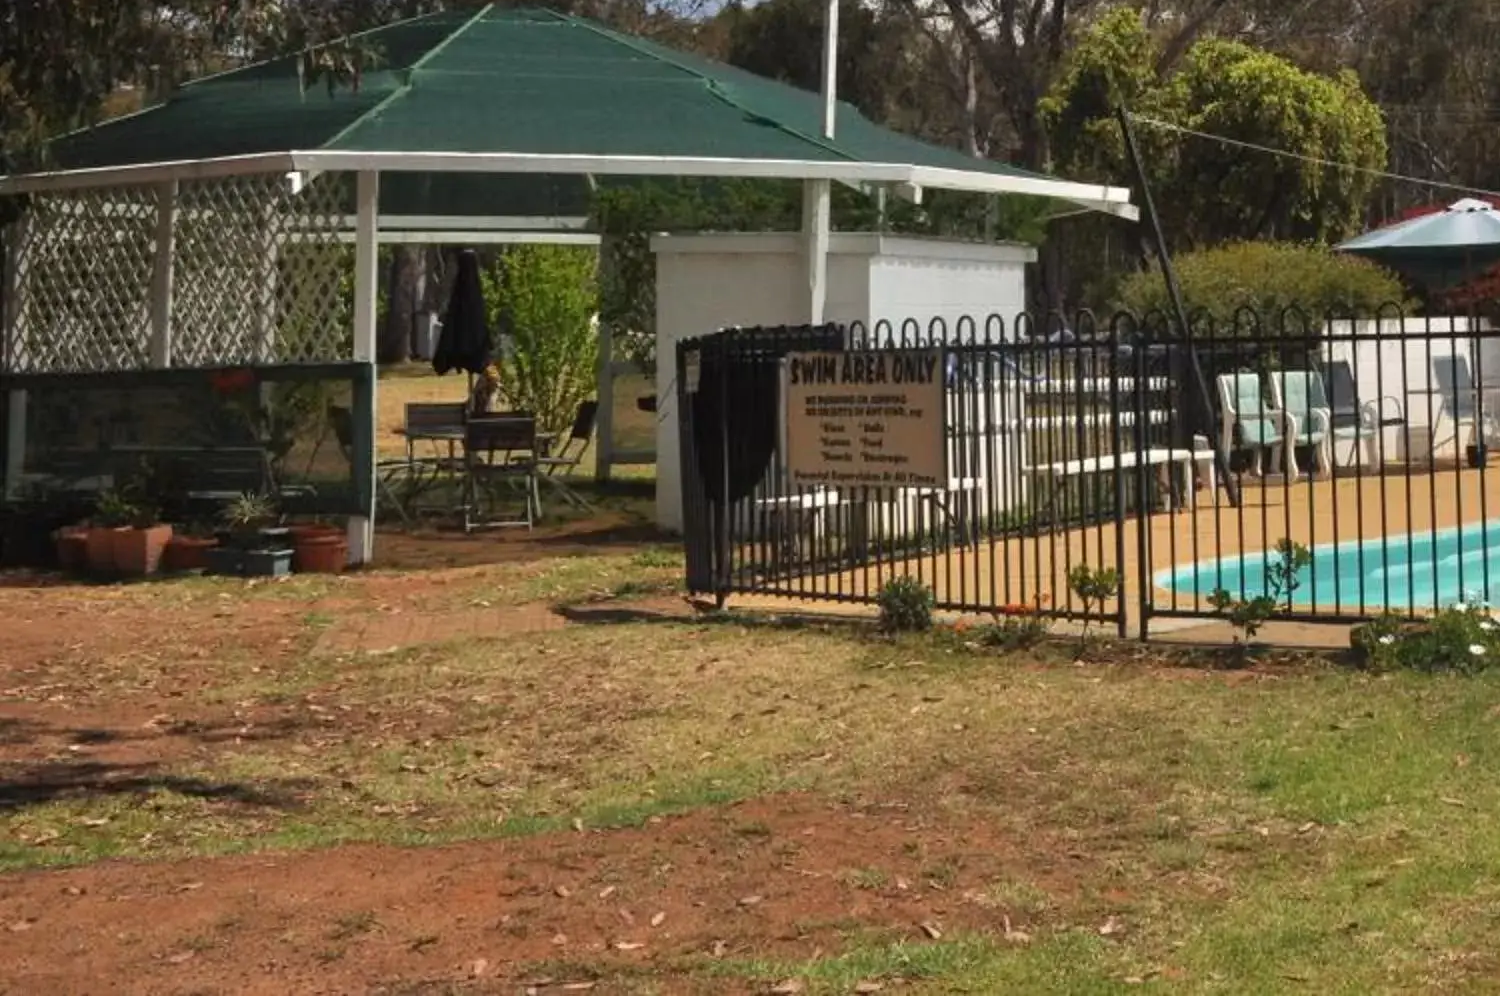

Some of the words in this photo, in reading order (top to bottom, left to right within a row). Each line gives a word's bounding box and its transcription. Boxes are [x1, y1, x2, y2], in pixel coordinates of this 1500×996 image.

[790, 357, 836, 385] SWIM
[841, 354, 887, 385] AREA
[891, 354, 938, 384] ONLY
